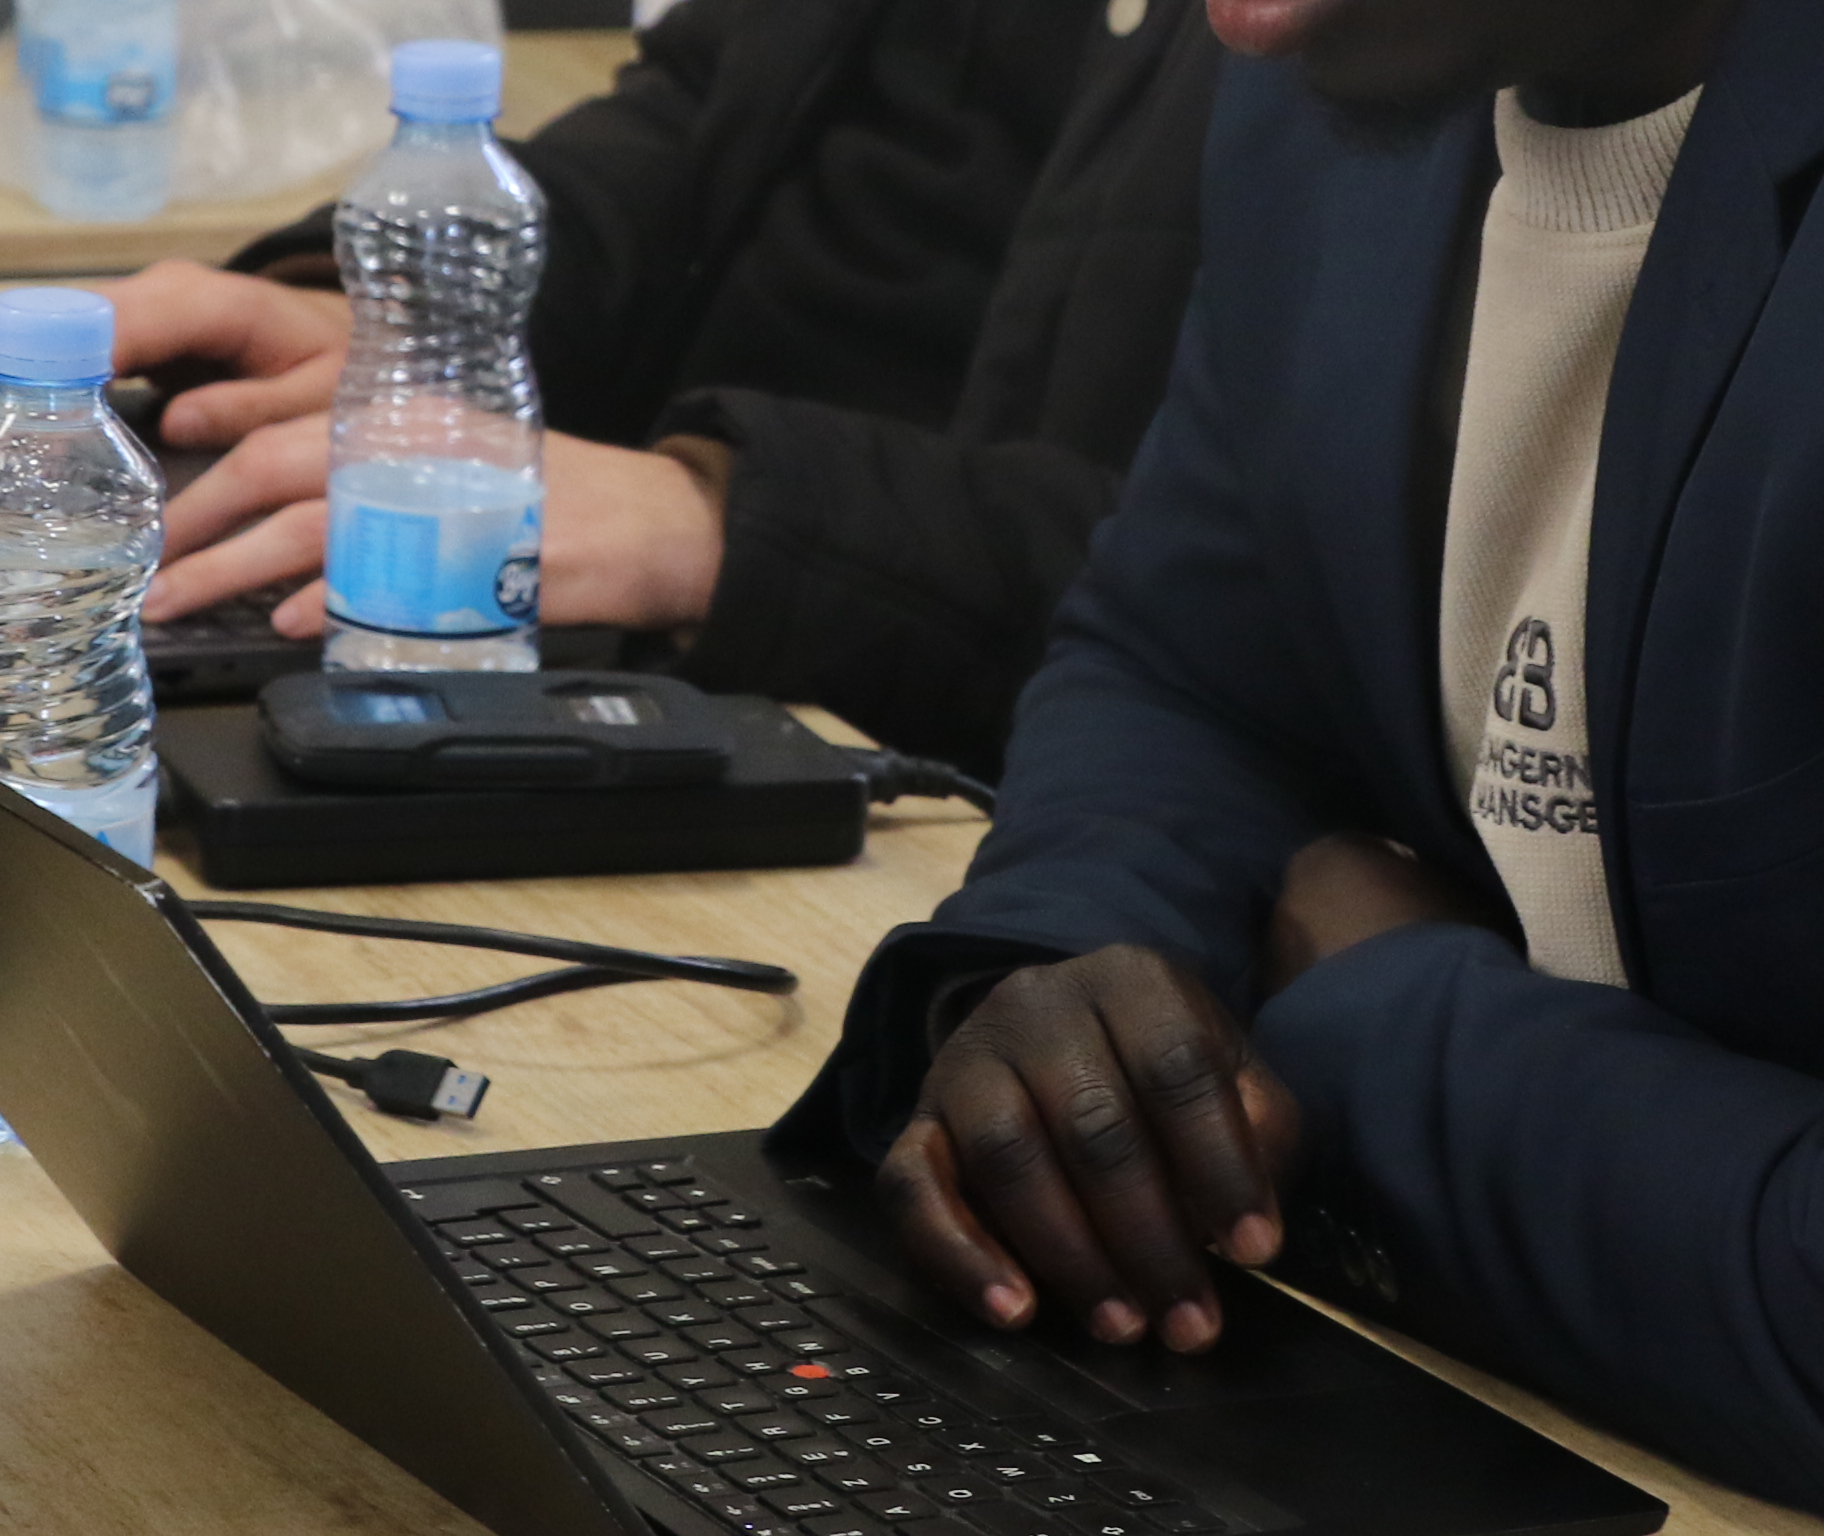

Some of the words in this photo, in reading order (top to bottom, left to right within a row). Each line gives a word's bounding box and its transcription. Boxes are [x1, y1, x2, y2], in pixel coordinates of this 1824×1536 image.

[1474, 785, 1600, 834] ANSGE
[592, 1265, 621, 1275] M
[533, 1280, 559, 1288] P
[636, 1290, 658, 1299] L
[568, 1302, 594, 1311] O
[668, 1313, 695, 1322] K
[796, 1342, 824, 1351] N
[642, 1351, 670, 1360] U
[744, 1361, 772, 1371] H
[844, 1366, 871, 1376] B
[680, 1377, 706, 1385] Y
[784, 1386, 810, 1395] G
[875, 1392, 901, 1400] V
[720, 1402, 746, 1410] T
[824, 1413, 852, 1421] F
[917, 1416, 943, 1425] C
[760, 1426, 788, 1436] R
[865, 1437, 892, 1446] D
[958, 1442, 987, 1451] X
[800, 1451, 829, 1461] E
[906, 1463, 932, 1472] S
[995, 1467, 1026, 1477] W
[841, 1478, 870, 1487] Z
[884, 1505, 912, 1514] A
